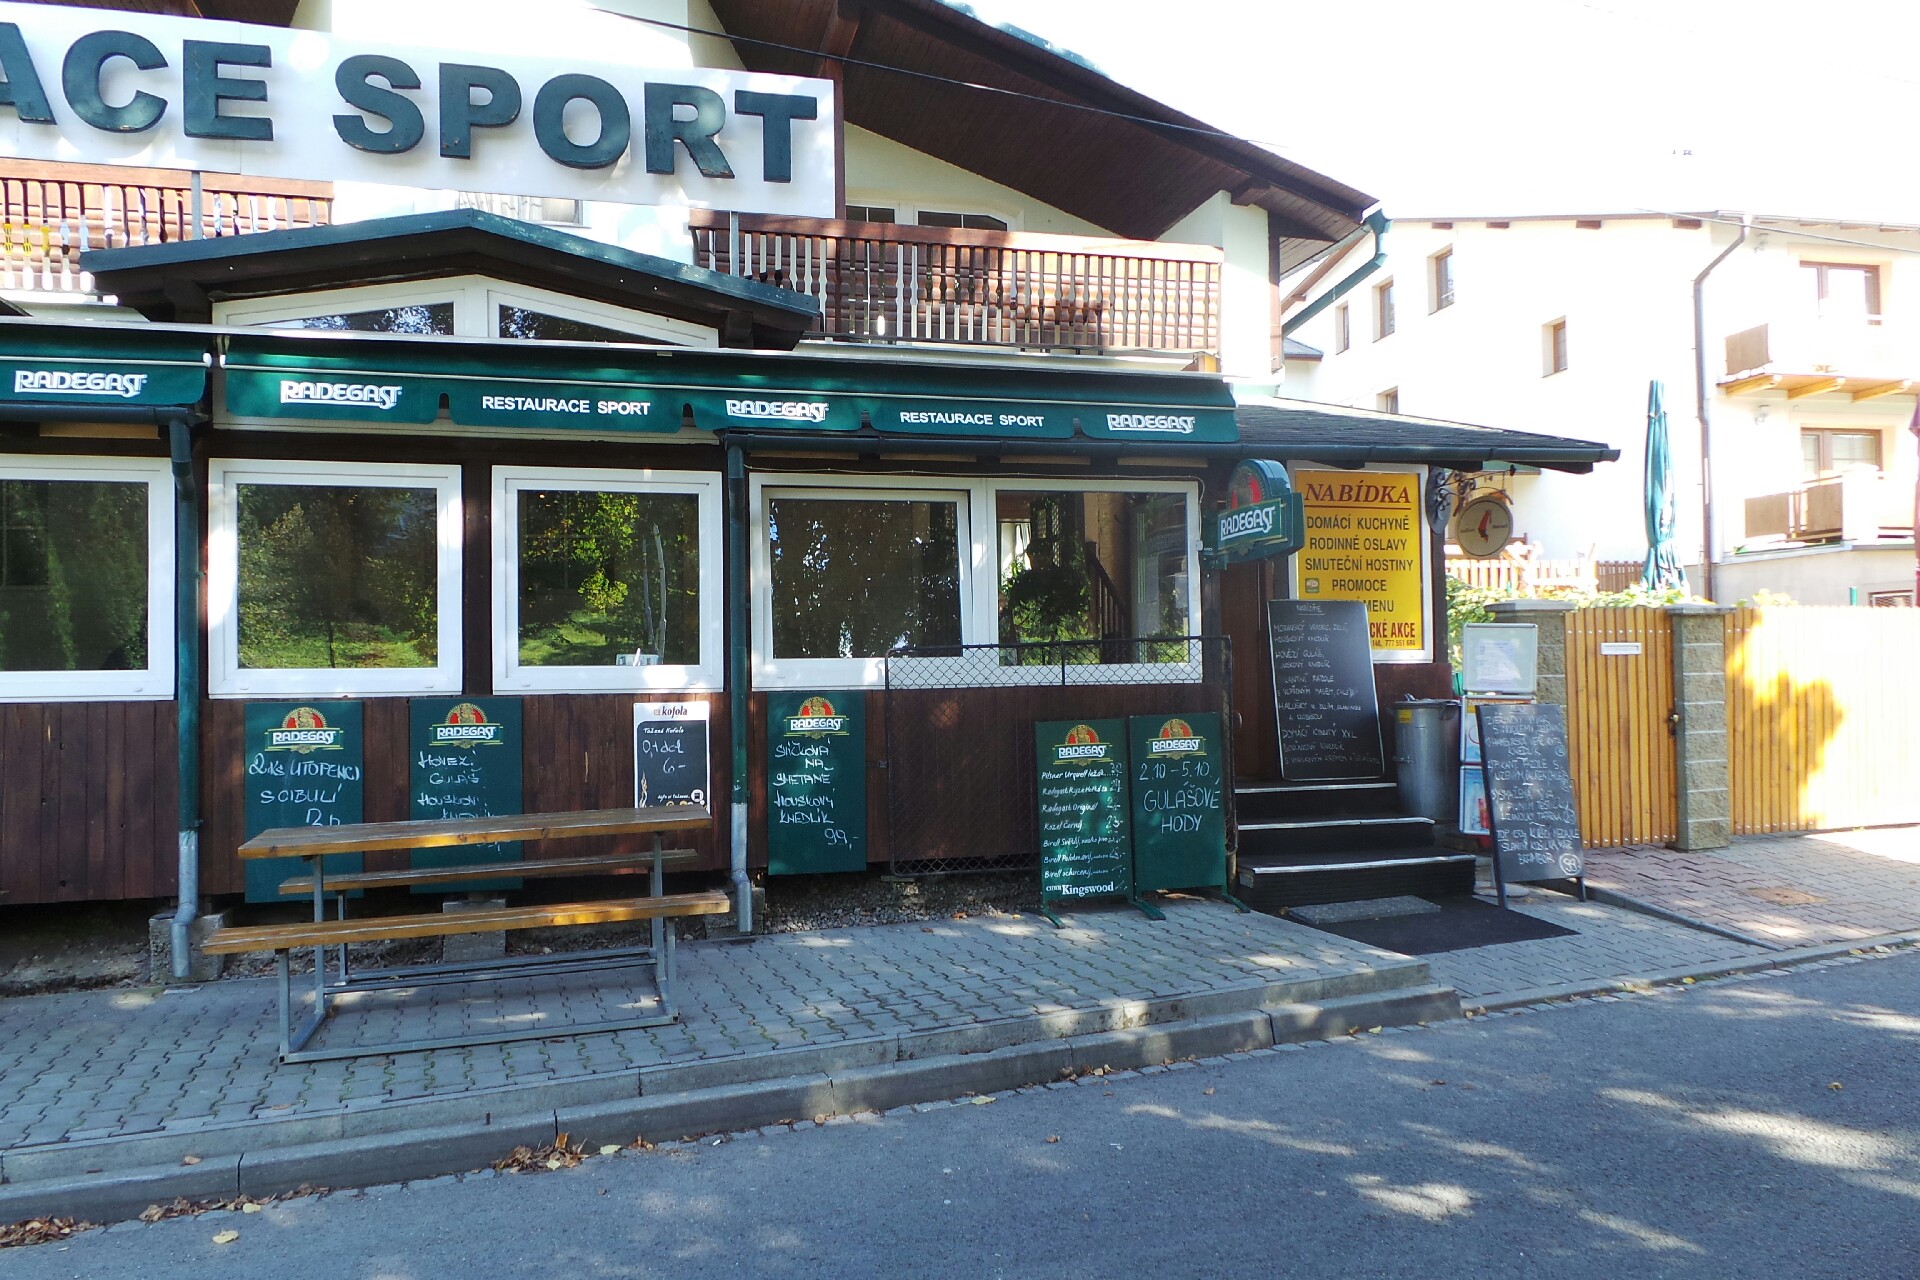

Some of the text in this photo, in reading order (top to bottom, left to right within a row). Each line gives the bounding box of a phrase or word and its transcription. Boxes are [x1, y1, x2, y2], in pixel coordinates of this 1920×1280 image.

[333, 54, 818, 183] SPORT
[14, 370, 147, 398] RADEGAST
[280, 380, 402, 410] RADEGAST
[482, 395, 650, 416] RESTAURACE SPORT
[725, 399, 830, 423] RADEGAST
[900, 411, 1045, 428] RESTAURACE SPORT
[1106, 413, 1196, 434] RADEGAST
[1305, 479, 1412, 504] NABÍDKA
[1220, 506, 1276, 541] RADEGAST
[1306, 514, 1410, 531] DOMÁCÍ KUCHYNĚ
[1309, 534, 1407, 551] RODINNÉ OSLAVY
[1305, 555, 1413, 572] SMUTEČNÍ HOSTINY
[1332, 579, 1387, 592] PROMOCE
[1391, 622, 1416, 638] AKCE
[662, 706, 688, 718] kofola
[790, 718, 844, 731] RADEGAST
[272, 731, 337, 745] RADEGAST
[437, 727, 496, 740] RADEGAST
[1058, 745, 1108, 759] RADEGAST
[1152, 739, 1201, 752] RADEGAST
[805, 759, 824, 769] NA
[1041, 771, 1063, 780] Pilsner
[1143, 777, 1220, 812] GULÁŠOVÉ
[1042, 802, 1071, 816] Radegast
[1044, 821, 1061, 831] Kozel
[1161, 814, 1202, 833] HODY
[1061, 881, 1114, 897] Kingswood
